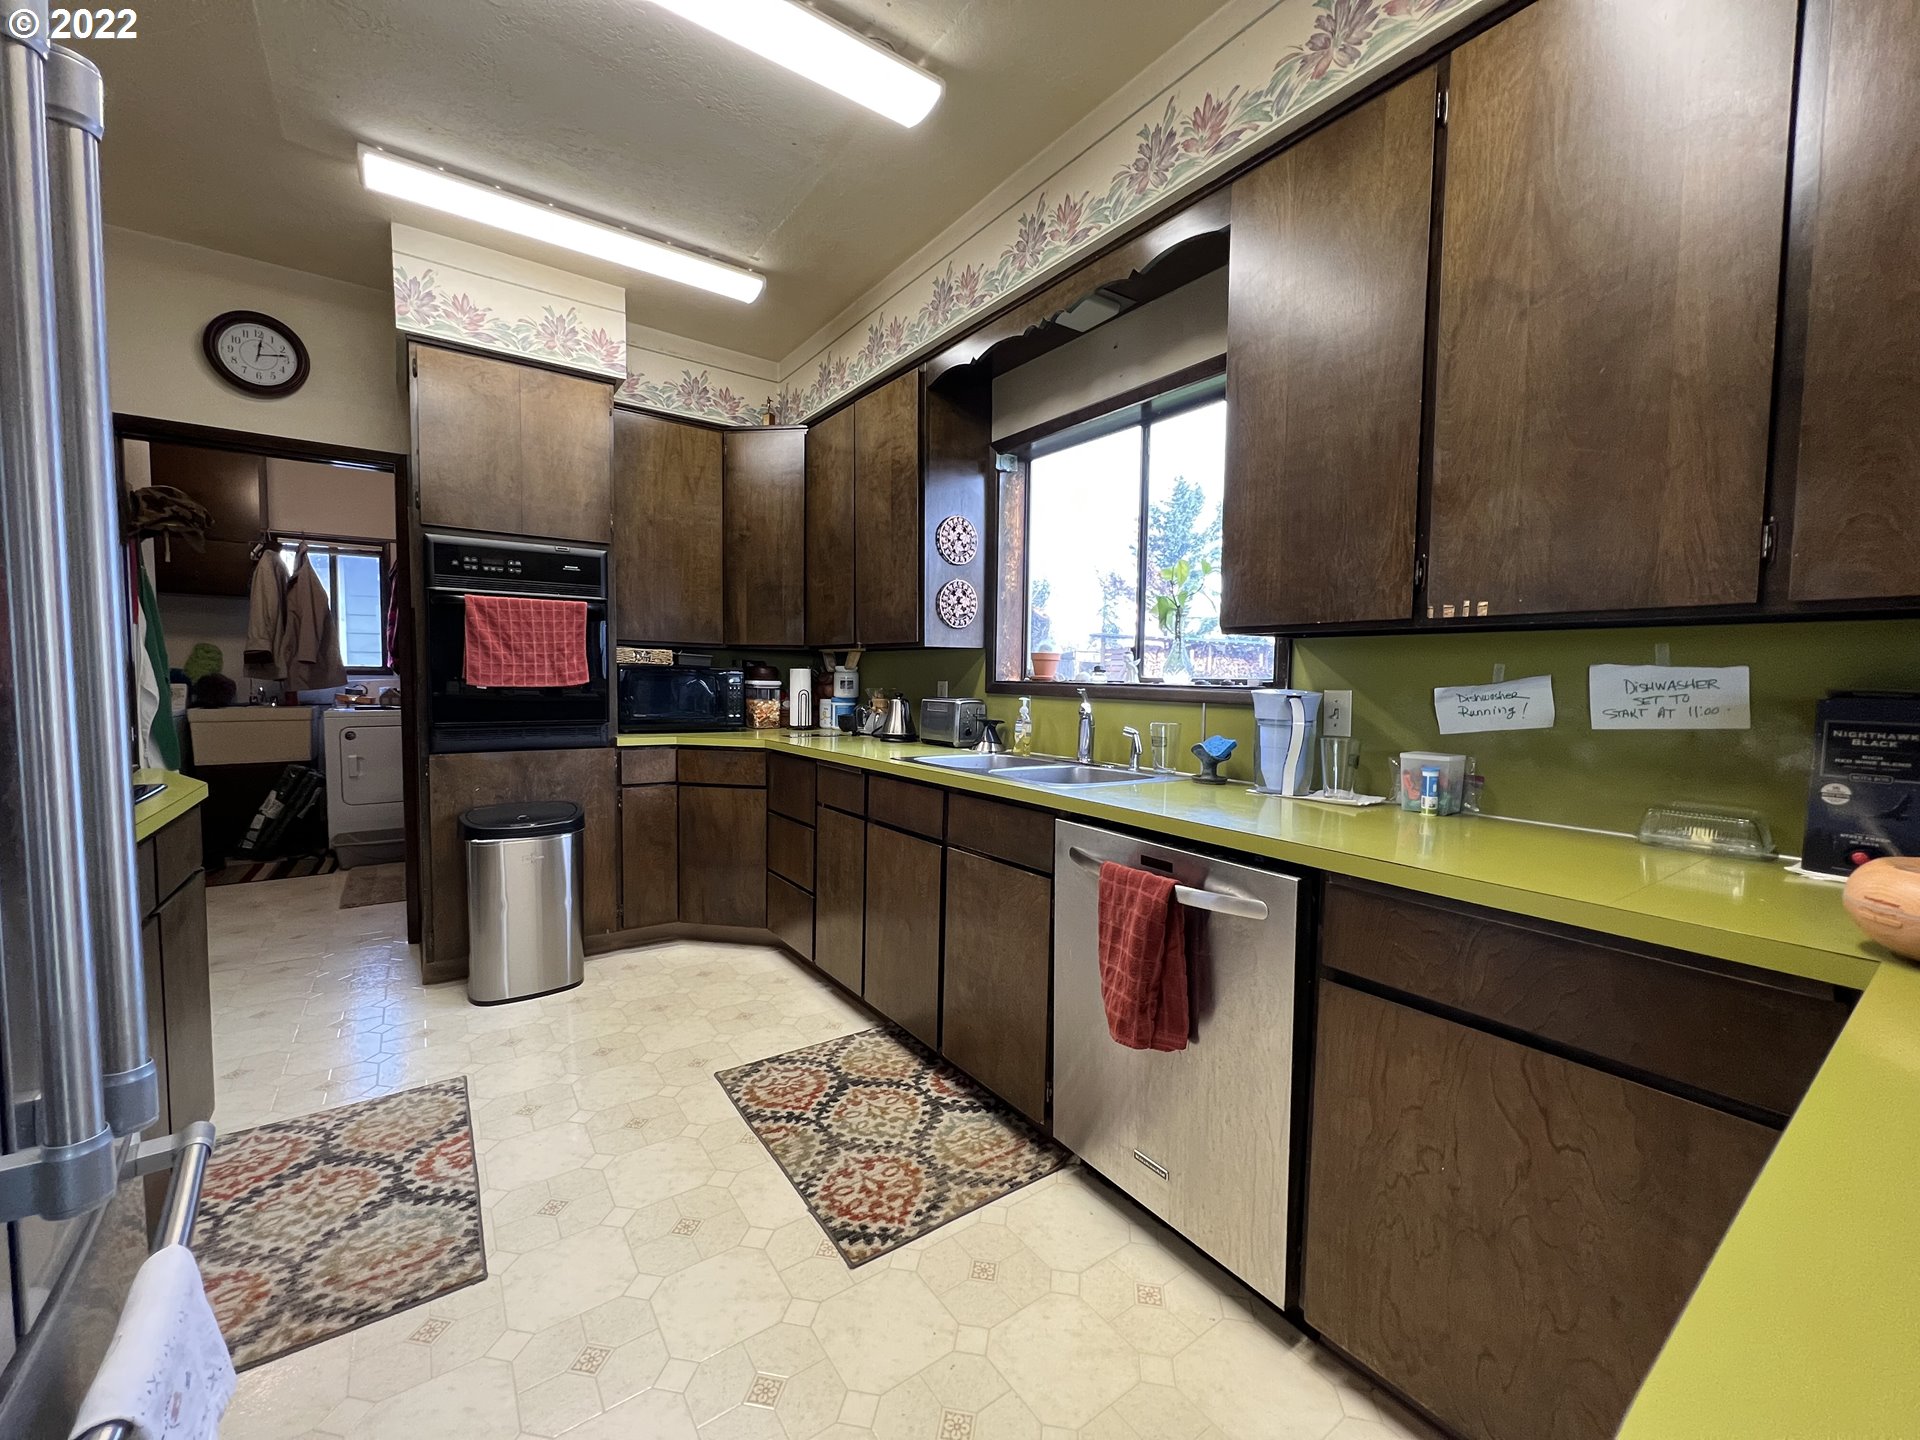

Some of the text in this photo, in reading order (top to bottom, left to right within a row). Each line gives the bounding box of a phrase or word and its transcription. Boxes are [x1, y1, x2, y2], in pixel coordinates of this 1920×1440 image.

[1632, 694, 1690, 706] SET TO
[1602, 706, 1719, 719] START AT 11:00
[1832, 730, 1919, 741] NIGHTHAWK
[1851, 738, 1898, 748] BLACK
